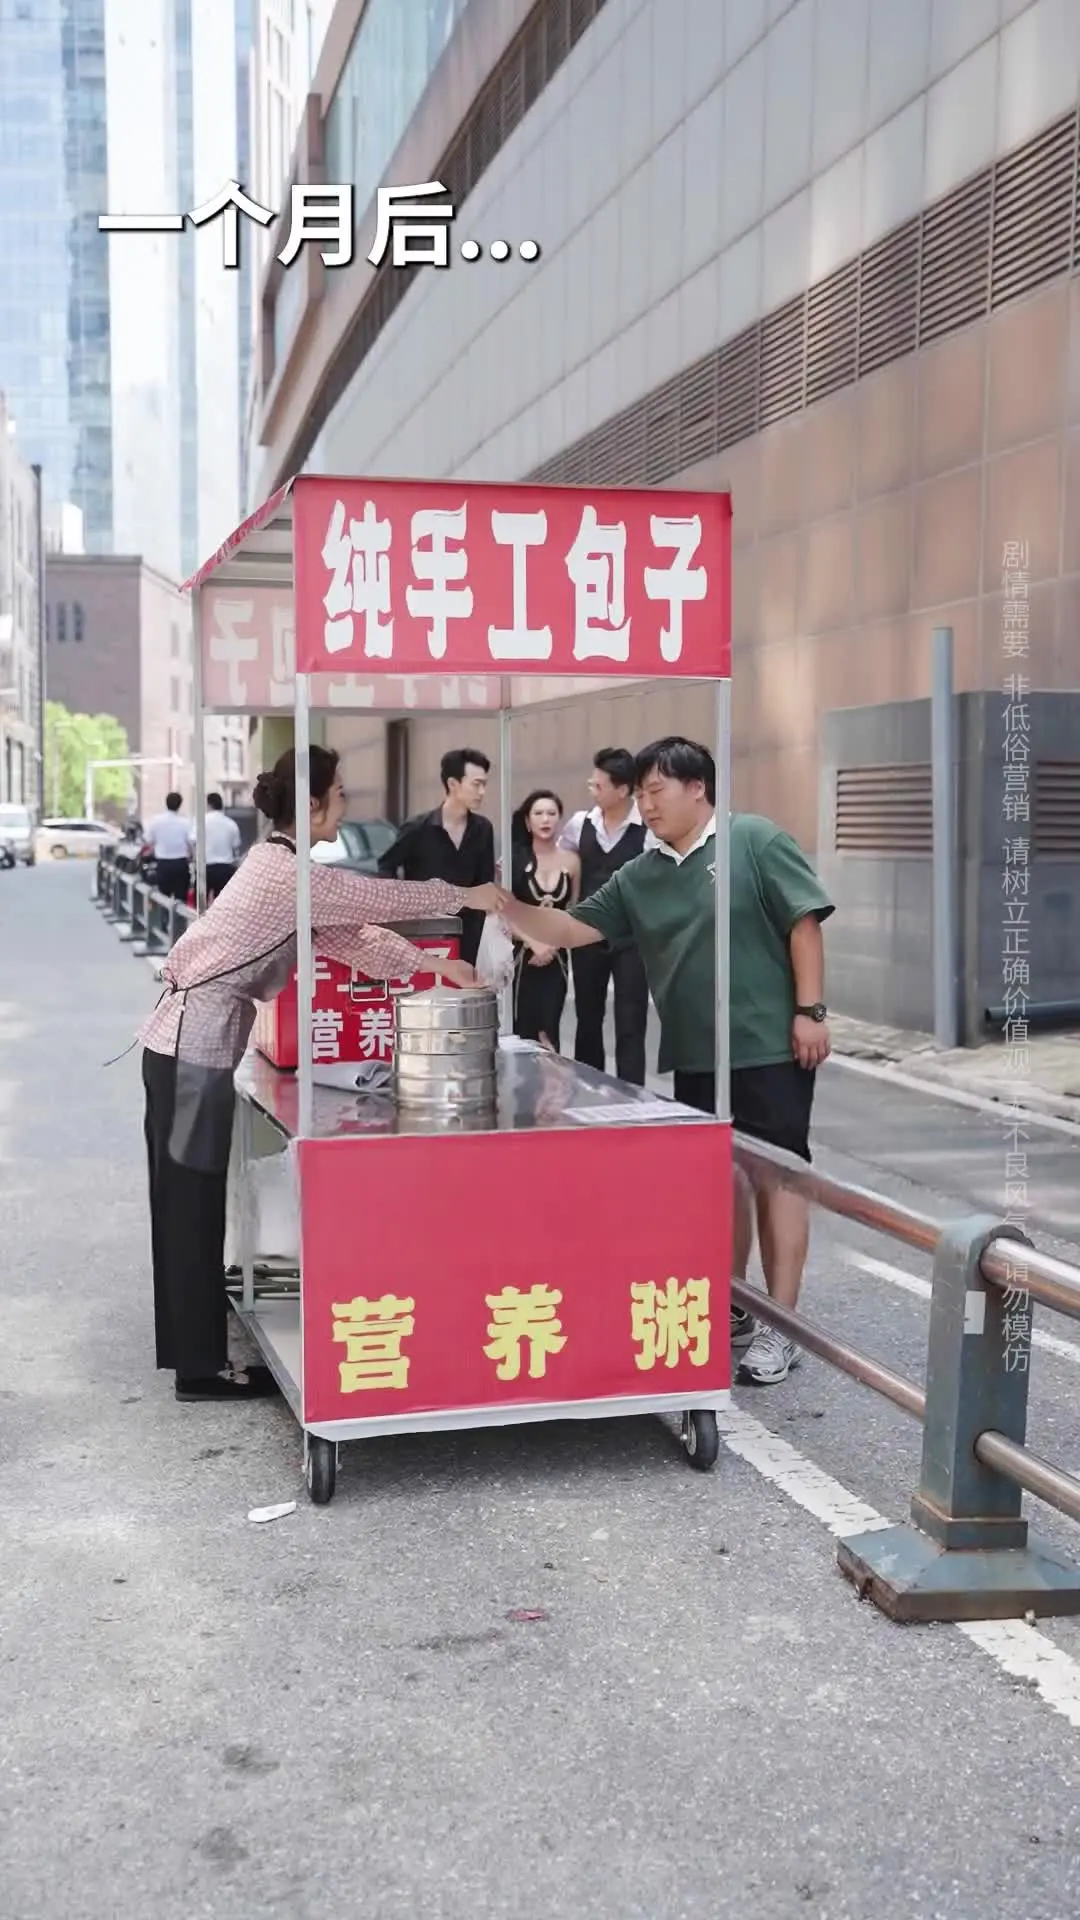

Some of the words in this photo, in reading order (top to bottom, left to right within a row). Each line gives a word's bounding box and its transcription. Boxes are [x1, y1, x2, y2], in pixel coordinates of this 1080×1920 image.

[321, 500, 708, 663] 纯手工包子
[331, 1276, 711, 1394] 营养粥
